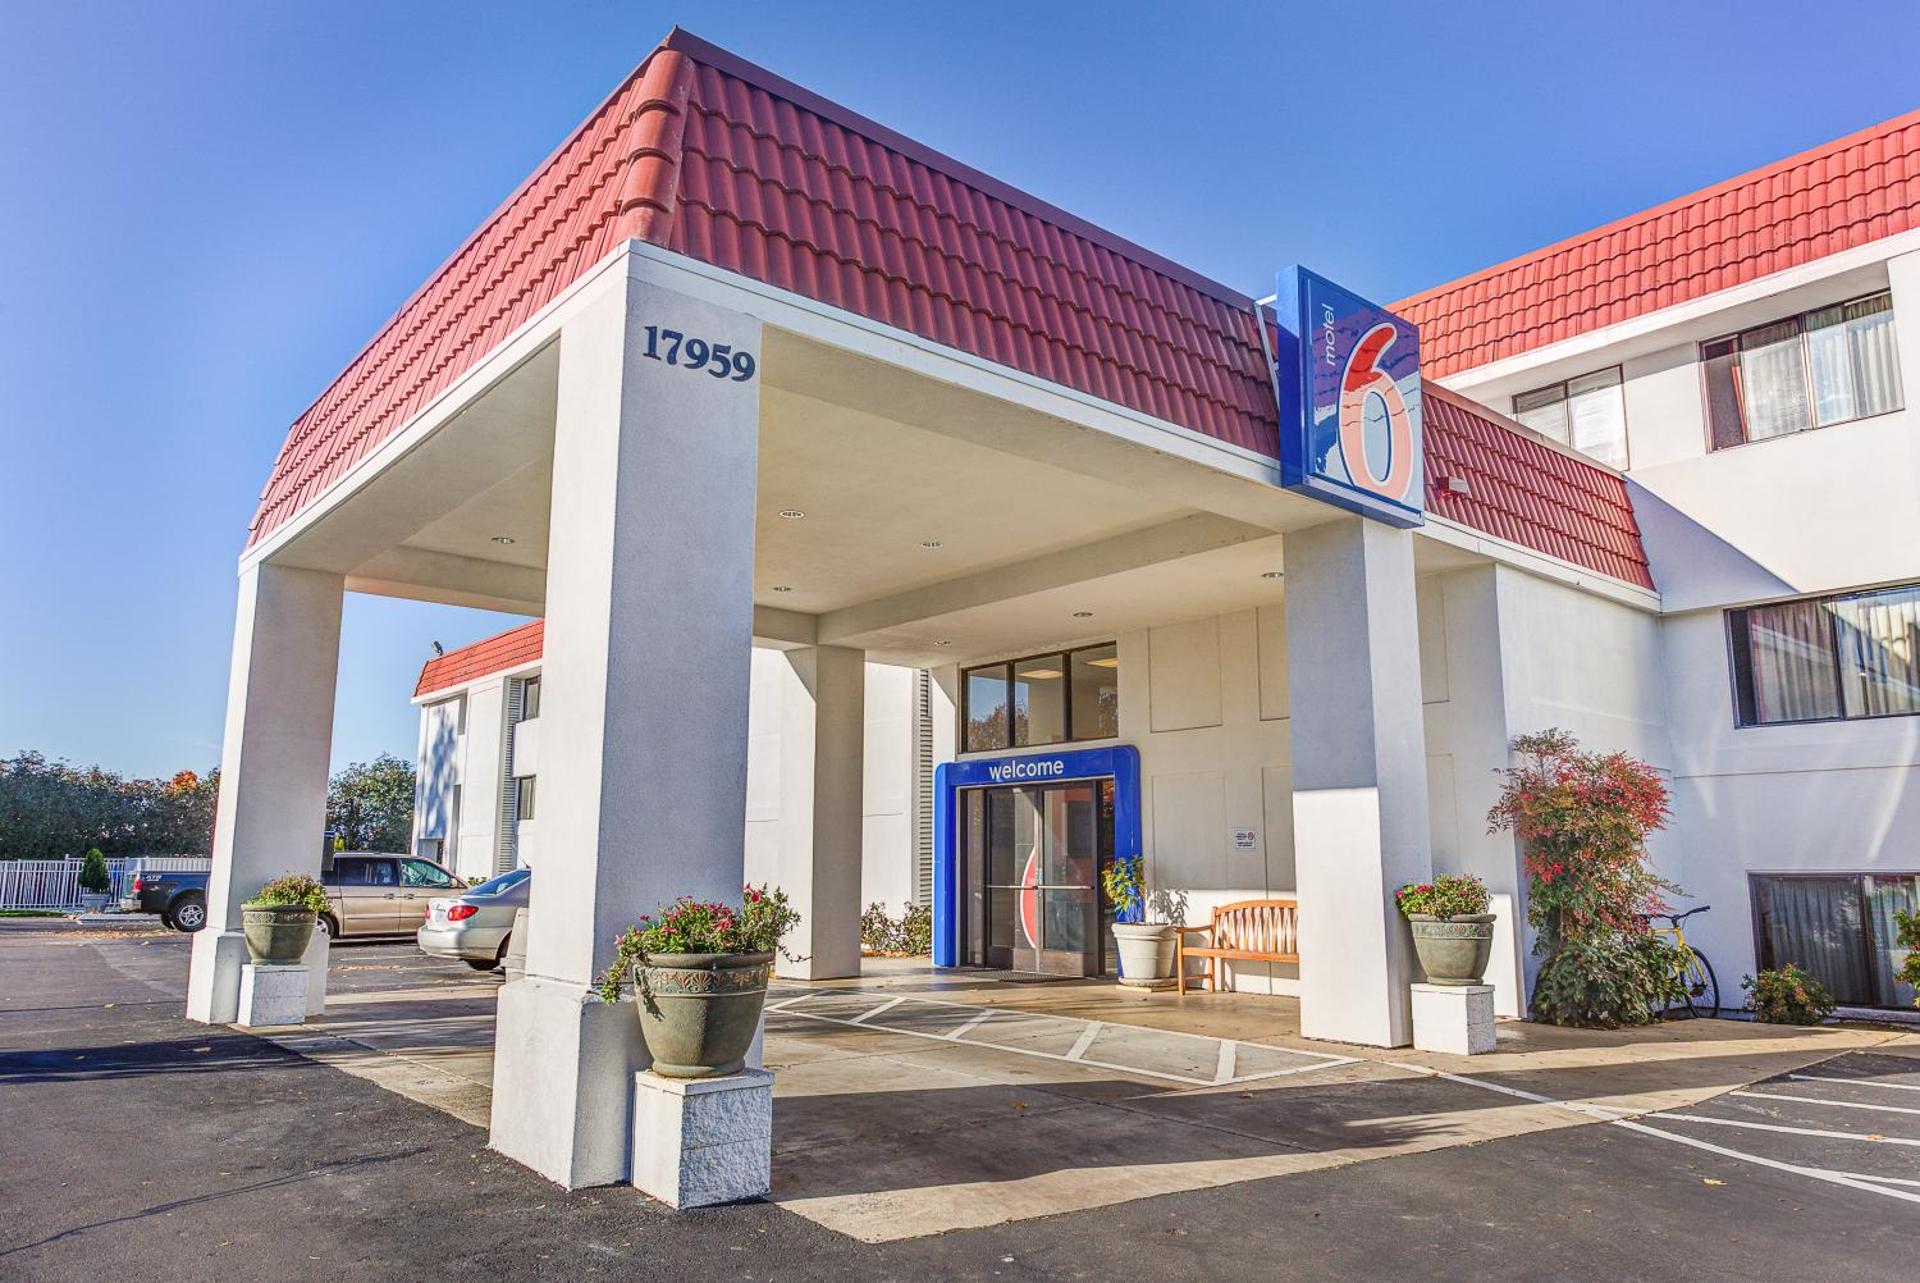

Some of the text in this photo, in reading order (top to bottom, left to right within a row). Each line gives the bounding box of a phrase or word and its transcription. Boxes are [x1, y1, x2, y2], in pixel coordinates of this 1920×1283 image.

[642, 326, 756, 382] 17959
[1321, 303, 1336, 366] motel
[1337, 322, 1414, 501] 6
[988, 760, 1065, 780] welcome
